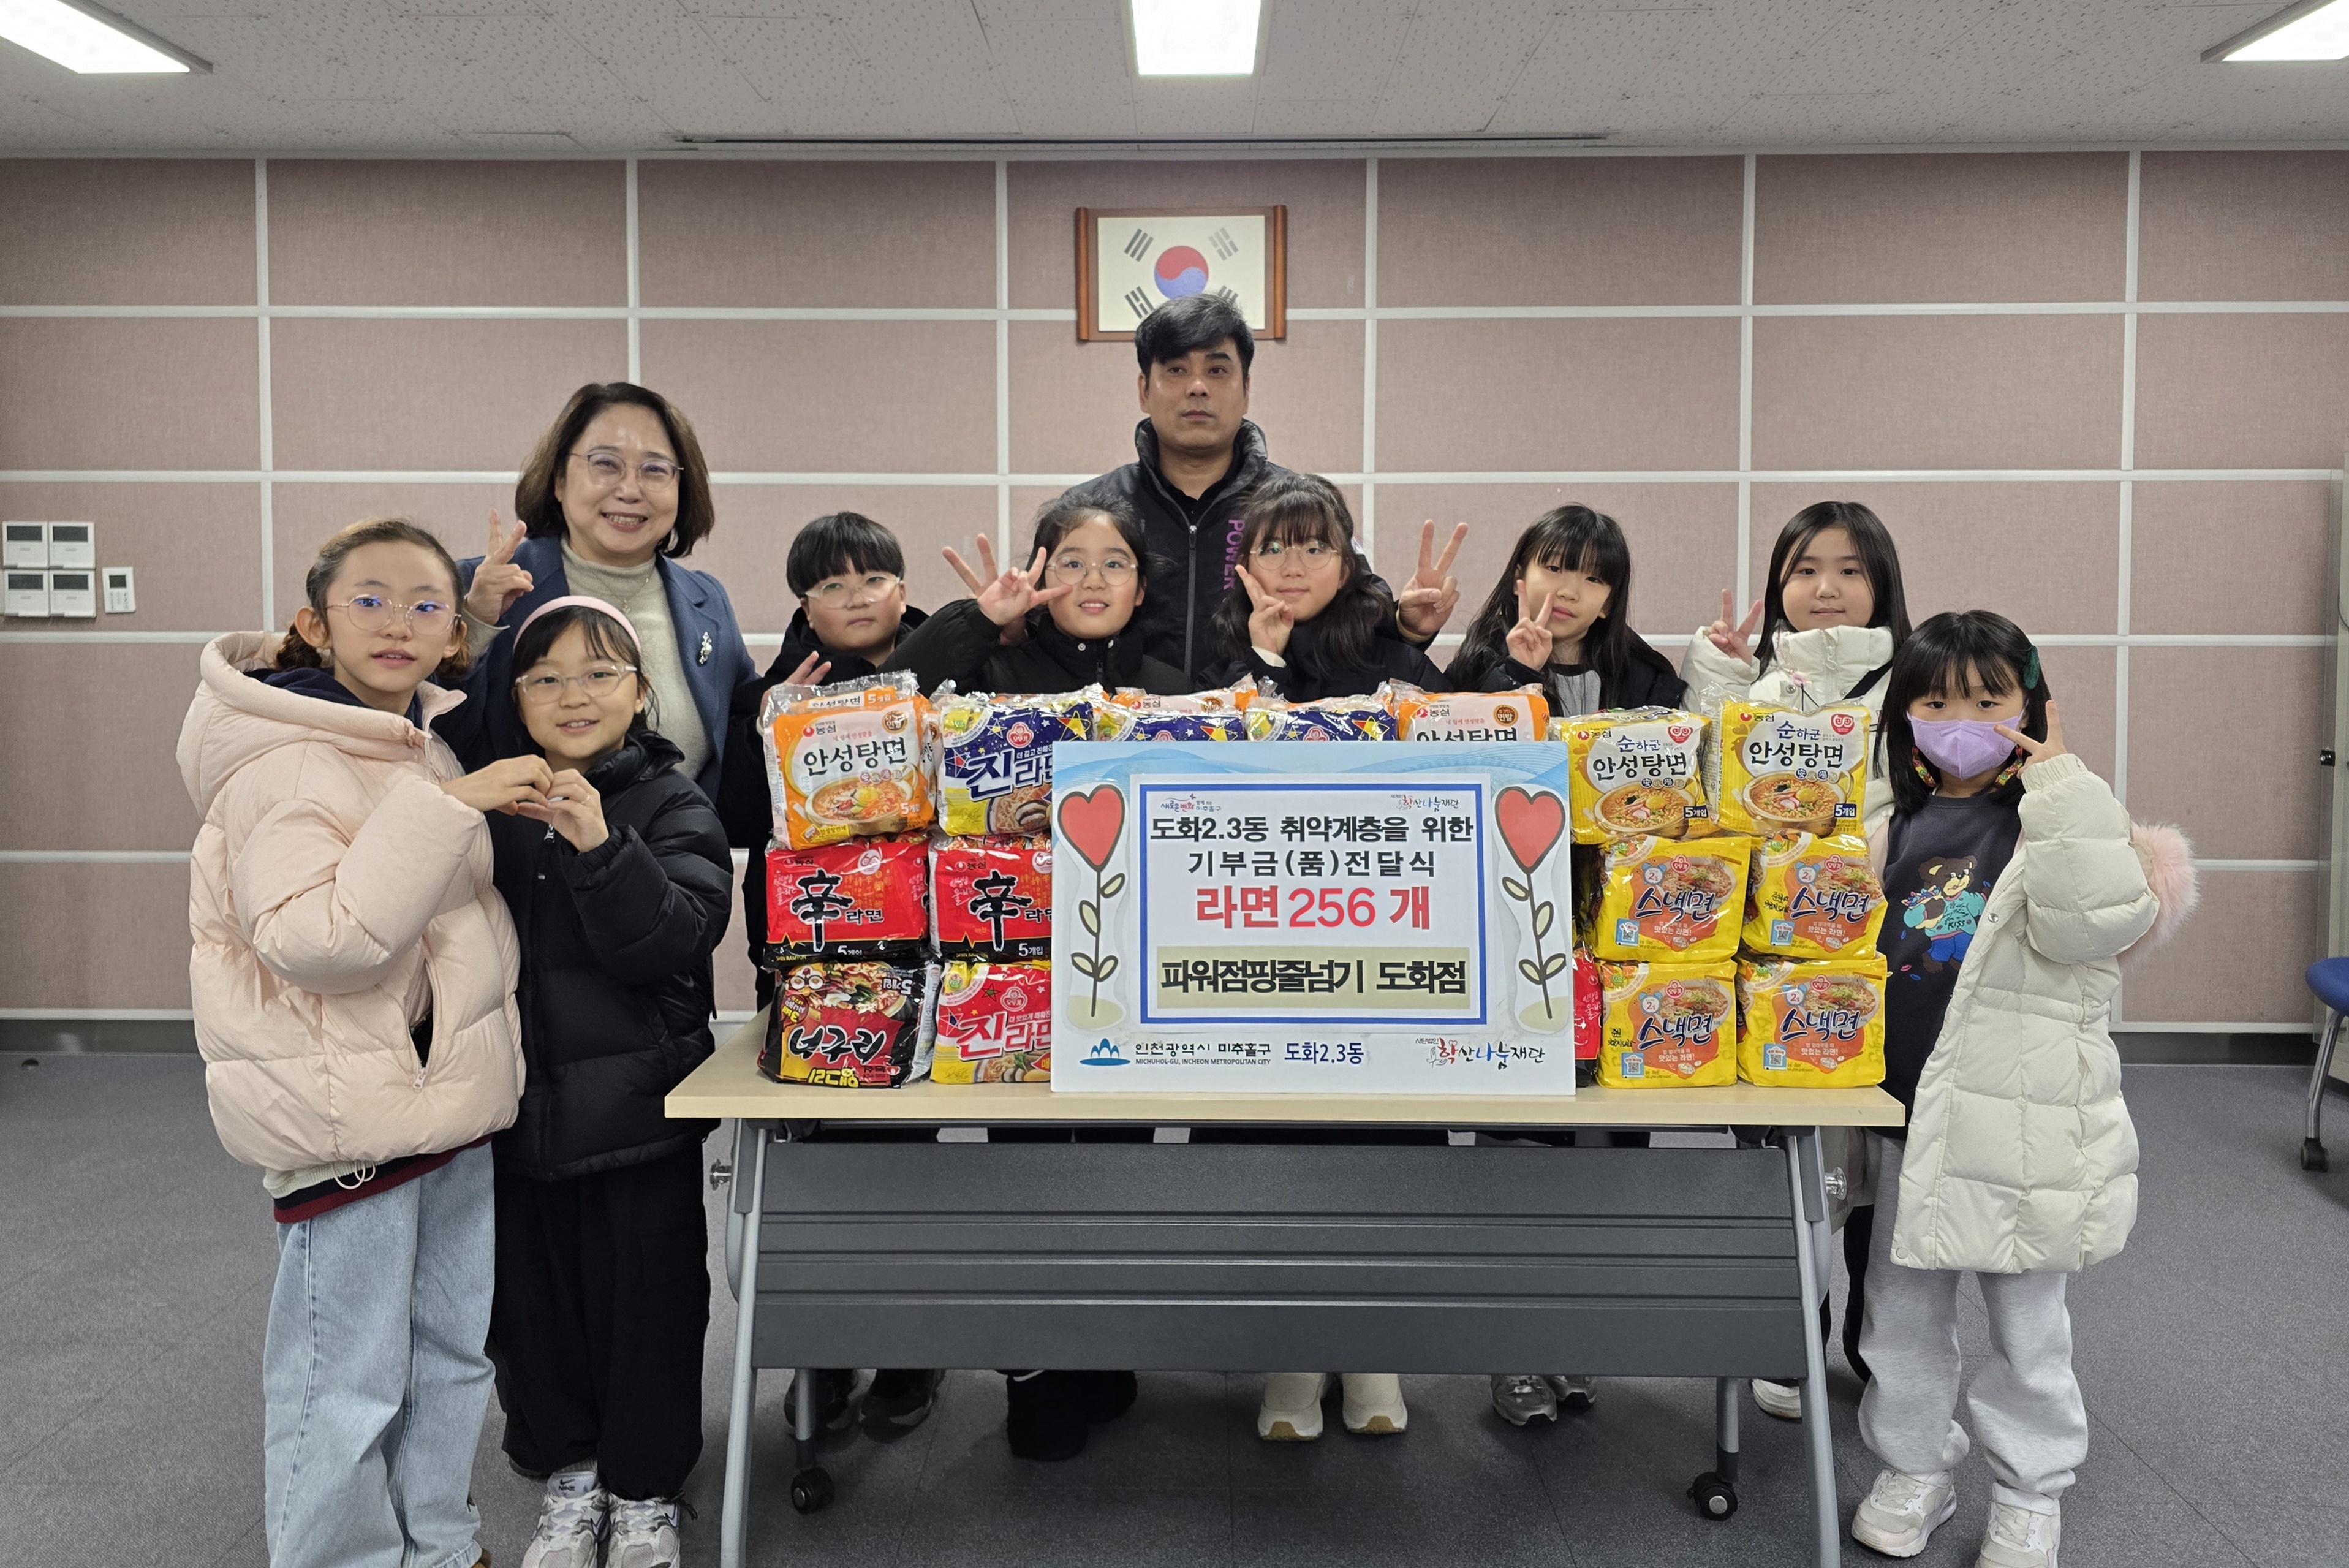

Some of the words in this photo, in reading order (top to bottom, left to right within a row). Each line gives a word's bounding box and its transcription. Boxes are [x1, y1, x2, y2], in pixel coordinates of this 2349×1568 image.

[1143, 699, 1160, 708] 농심
[1429, 708, 1450, 717] 농심
[816, 725, 836, 735] 농심
[1777, 720, 1821, 740] 순하군
[803, 737, 907, 776] 안성탕면
[1593, 752, 1687, 781] 안성탕면
[1749, 741, 1843, 768] 안성탕면
[1161, 801, 1179, 812] 새로운
[1180, 801, 1195, 812] 변화
[1685, 807, 1707, 817] 5개입
[1835, 805, 1855, 816] 5개입
[1150, 816, 1269, 843] 도화2.3동
[1280, 816, 1409, 843] 취약계층을
[1421, 816, 1474, 843] 위한
[1189, 850, 1435, 877] 기부금(품)전달식
[1197, 885, 1279, 929] 라면
[1288, 887, 1376, 927] 256
[1389, 886, 1430, 930] 개
[1635, 887, 1715, 922] 스낵면
[1790, 886, 1870, 923] 스낵면
[1654, 926, 1674, 934] 맛있는
[1807, 926, 1826, 934] 맛있는
[1948, 920, 1965, 930] KISS
[1019, 943, 1043, 956] 5개입
[1161, 960, 1364, 993] 파워점핑줄넘기
[1375, 960, 1466, 994] 도화점
[1637, 1013, 1712, 1050] 스낵면
[1780, 1009, 1861, 1042] 스낵면
[1135, 1043, 1209, 1057] 인천광역시
[1218, 1043, 1271, 1057] 미추홀구
[1285, 1042, 1364, 1064] 도화2.3동
[1438, 1037, 1545, 1070] 학산나눔재단
